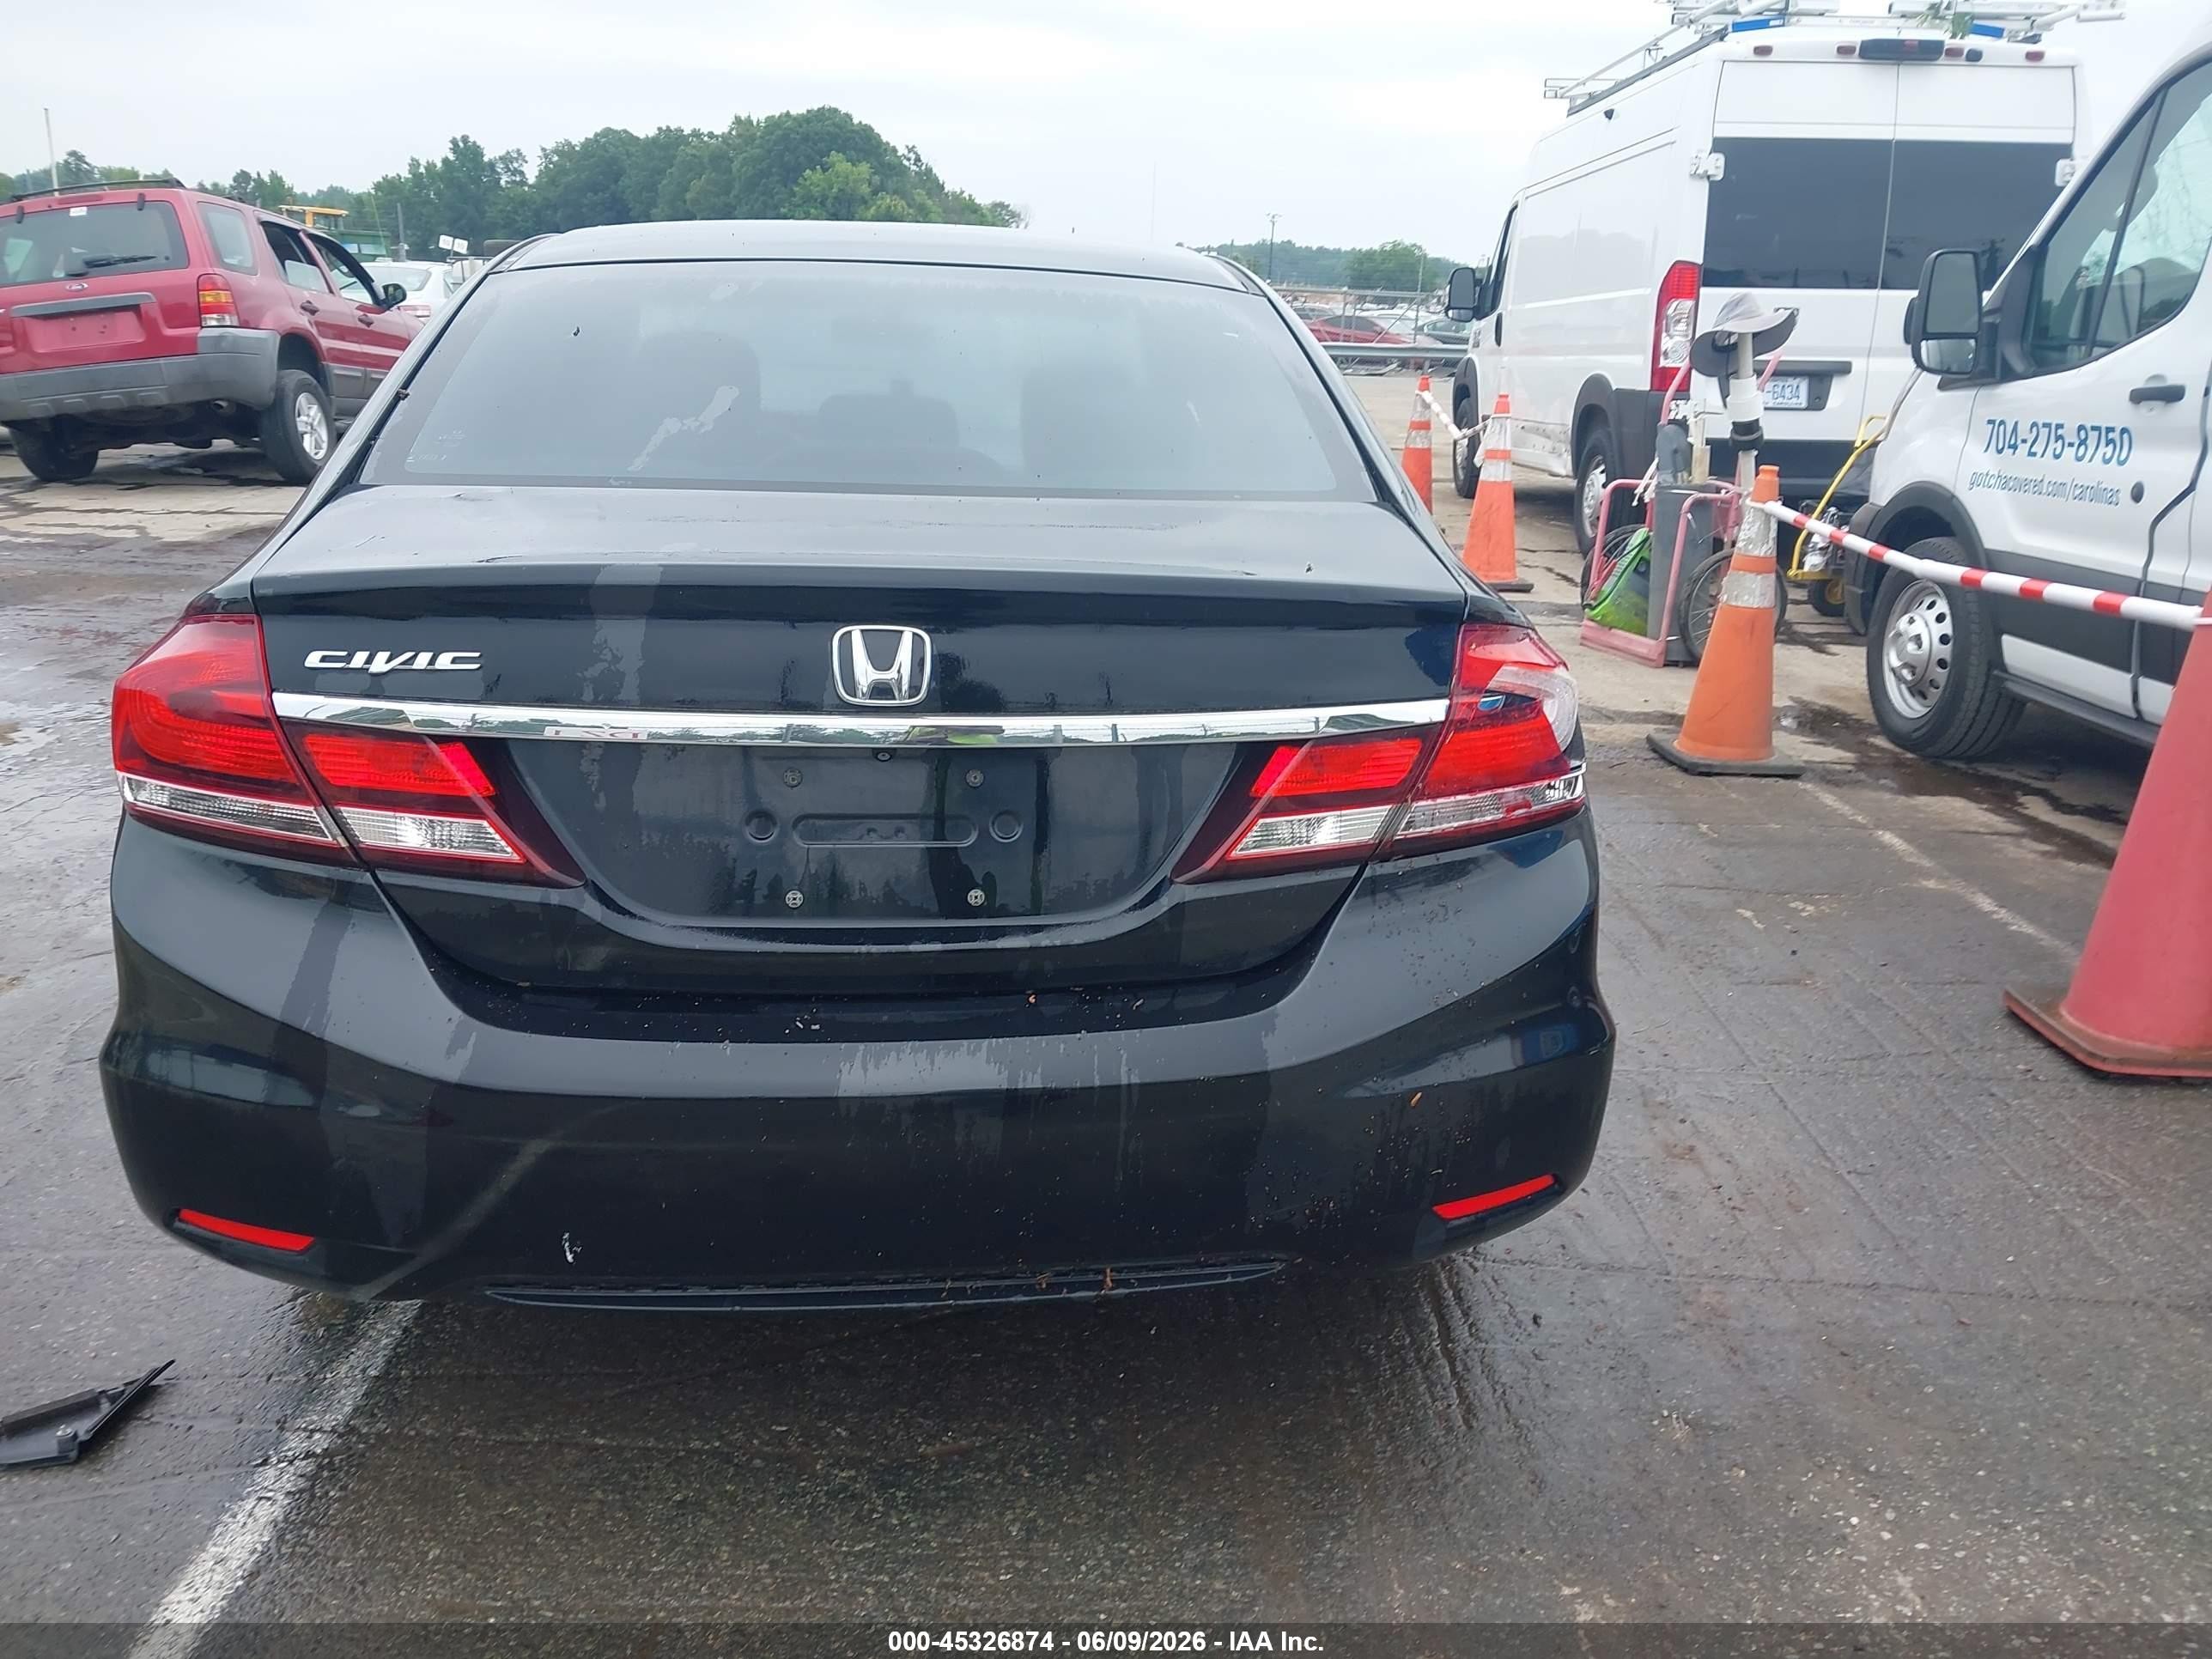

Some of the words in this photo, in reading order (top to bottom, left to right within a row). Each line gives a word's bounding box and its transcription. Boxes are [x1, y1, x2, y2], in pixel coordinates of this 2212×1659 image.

[1984, 419, 2132, 466] 704-275-8750
[1968, 469, 2121, 507] gotchacovered.com/carolinas
[304, 650, 481, 674] CIVIC
